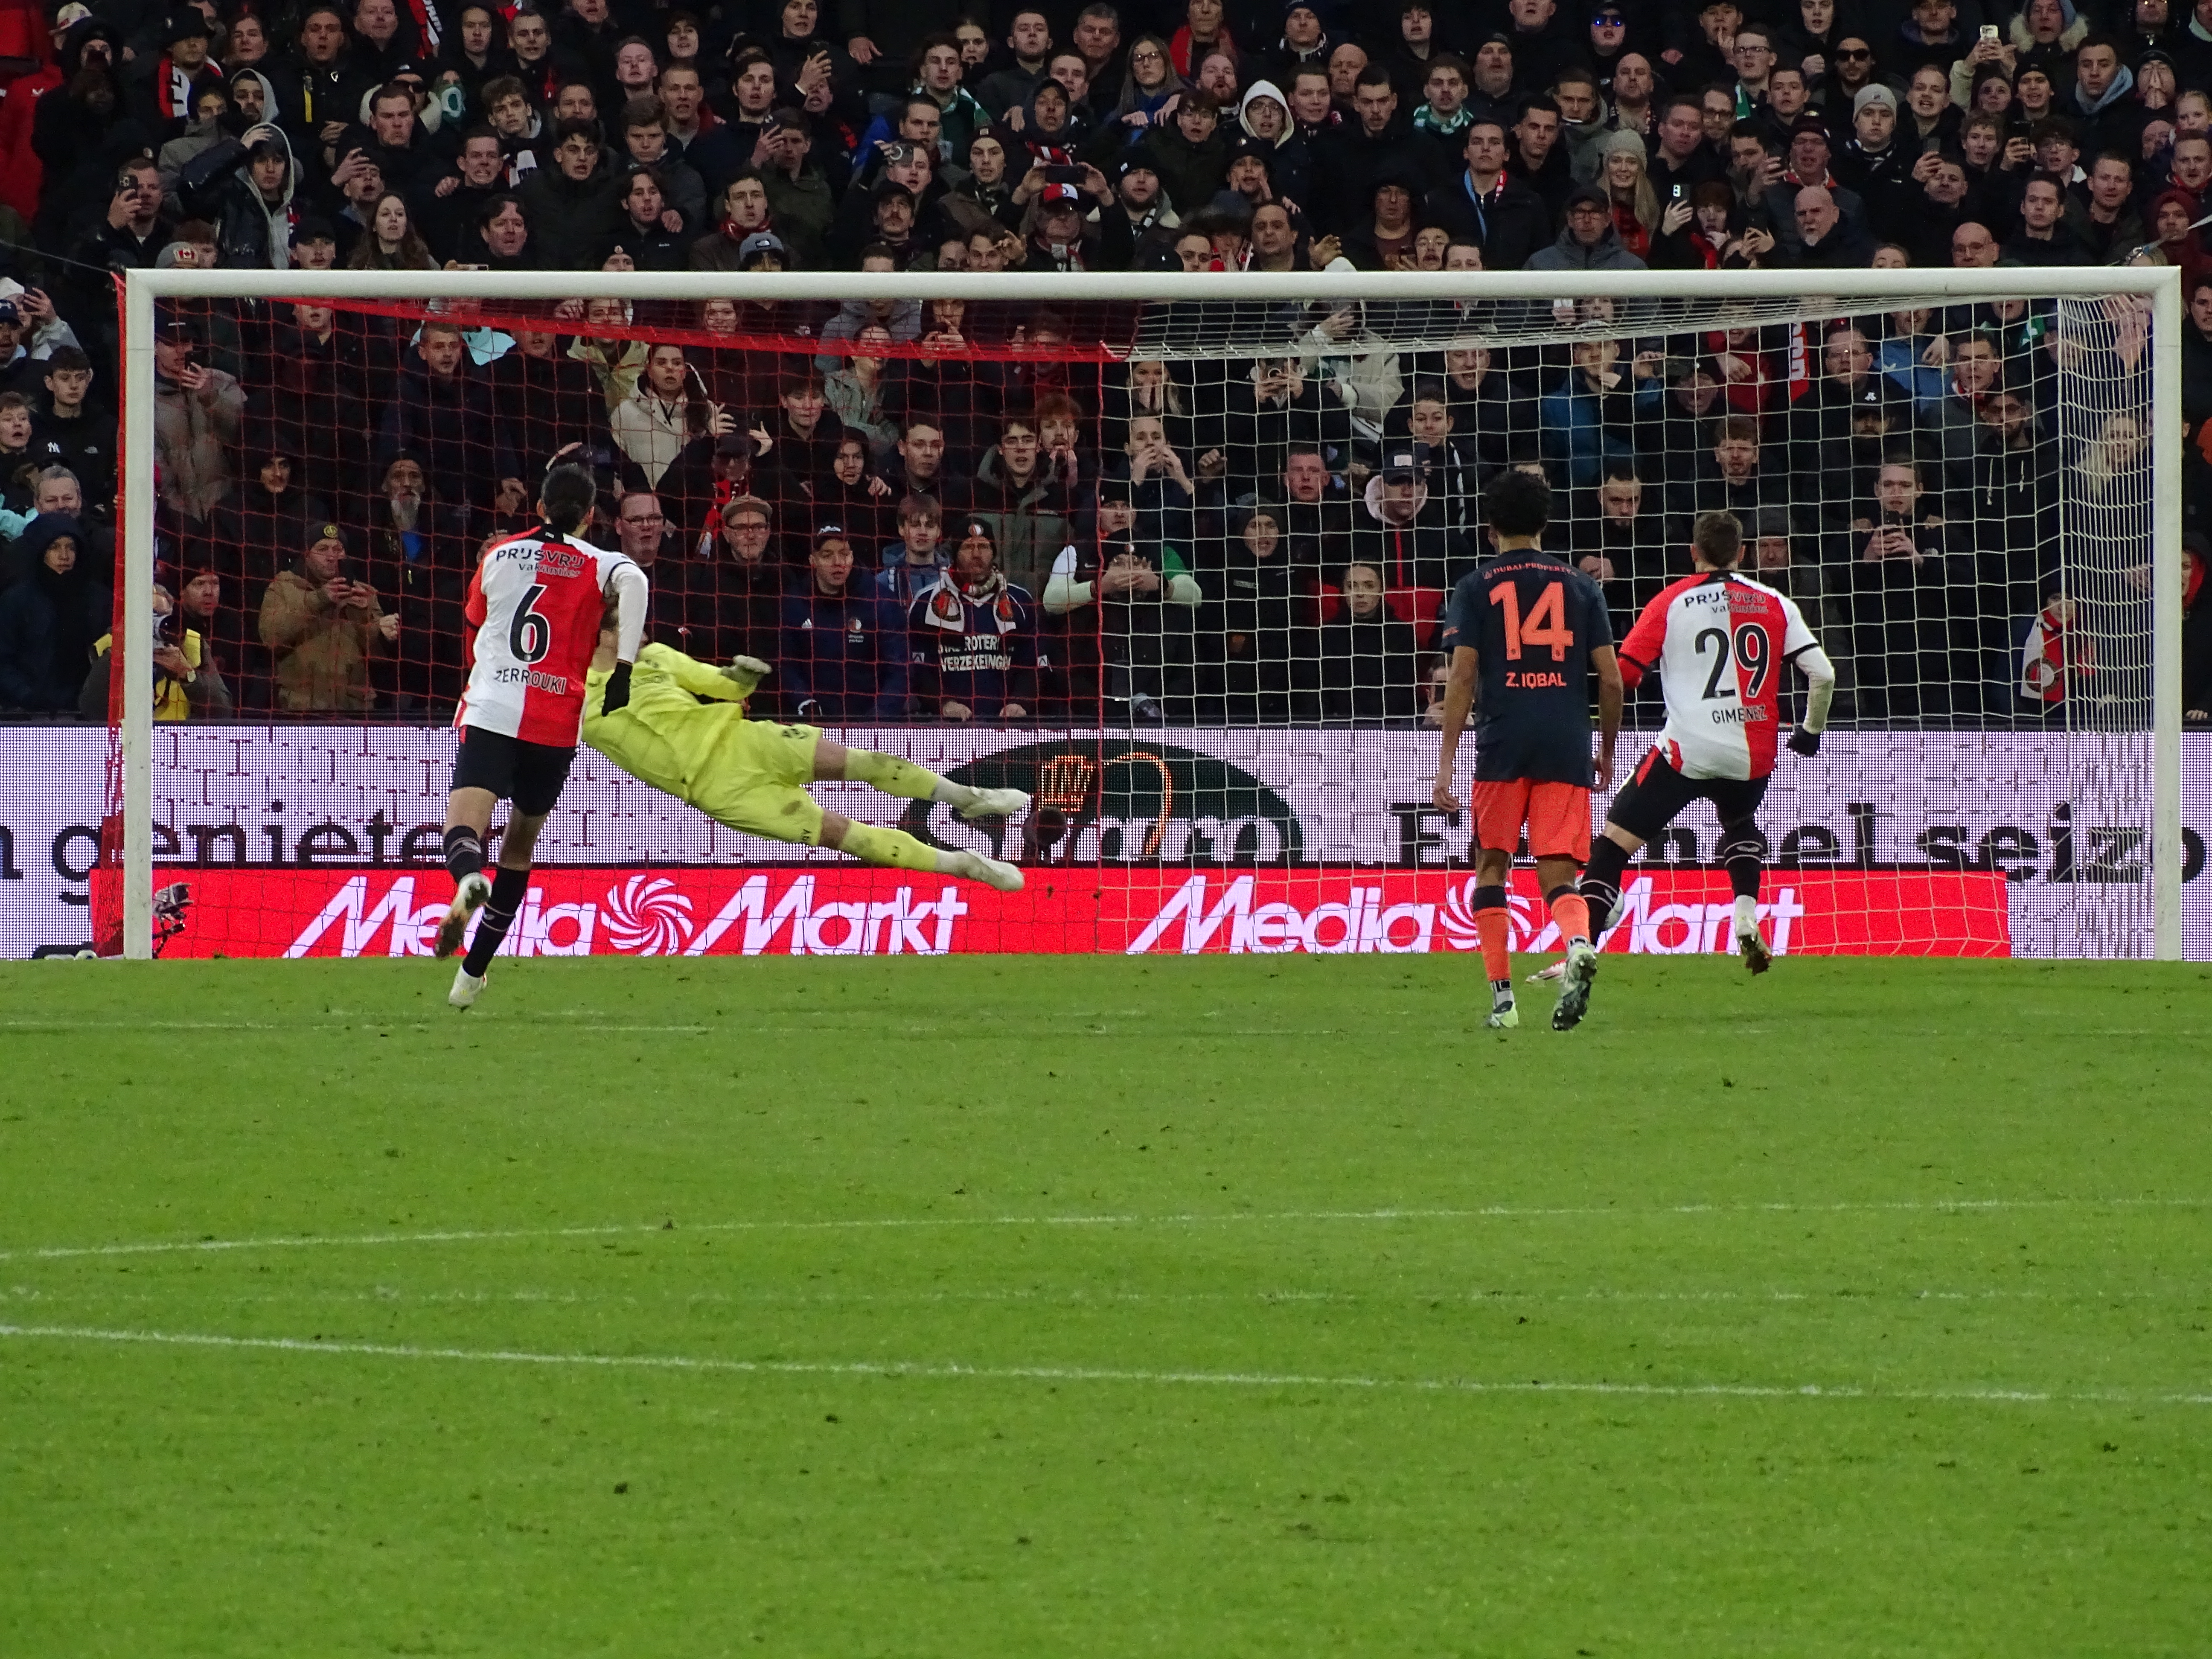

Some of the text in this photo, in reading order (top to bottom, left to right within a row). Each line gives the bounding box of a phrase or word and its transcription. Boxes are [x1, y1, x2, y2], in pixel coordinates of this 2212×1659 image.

[509, 583, 550, 664] 6
[1489, 581, 1574, 662] 14
[495, 668, 567, 695] ZERROUKI
[1505, 672, 1567, 690] Z. IQBAL
[1694, 622, 1770, 701] 29
[1711, 704, 1768, 725] GIMENEZ
[684, 874, 968, 956] Markt
[1125, 874, 1435, 954] Media
